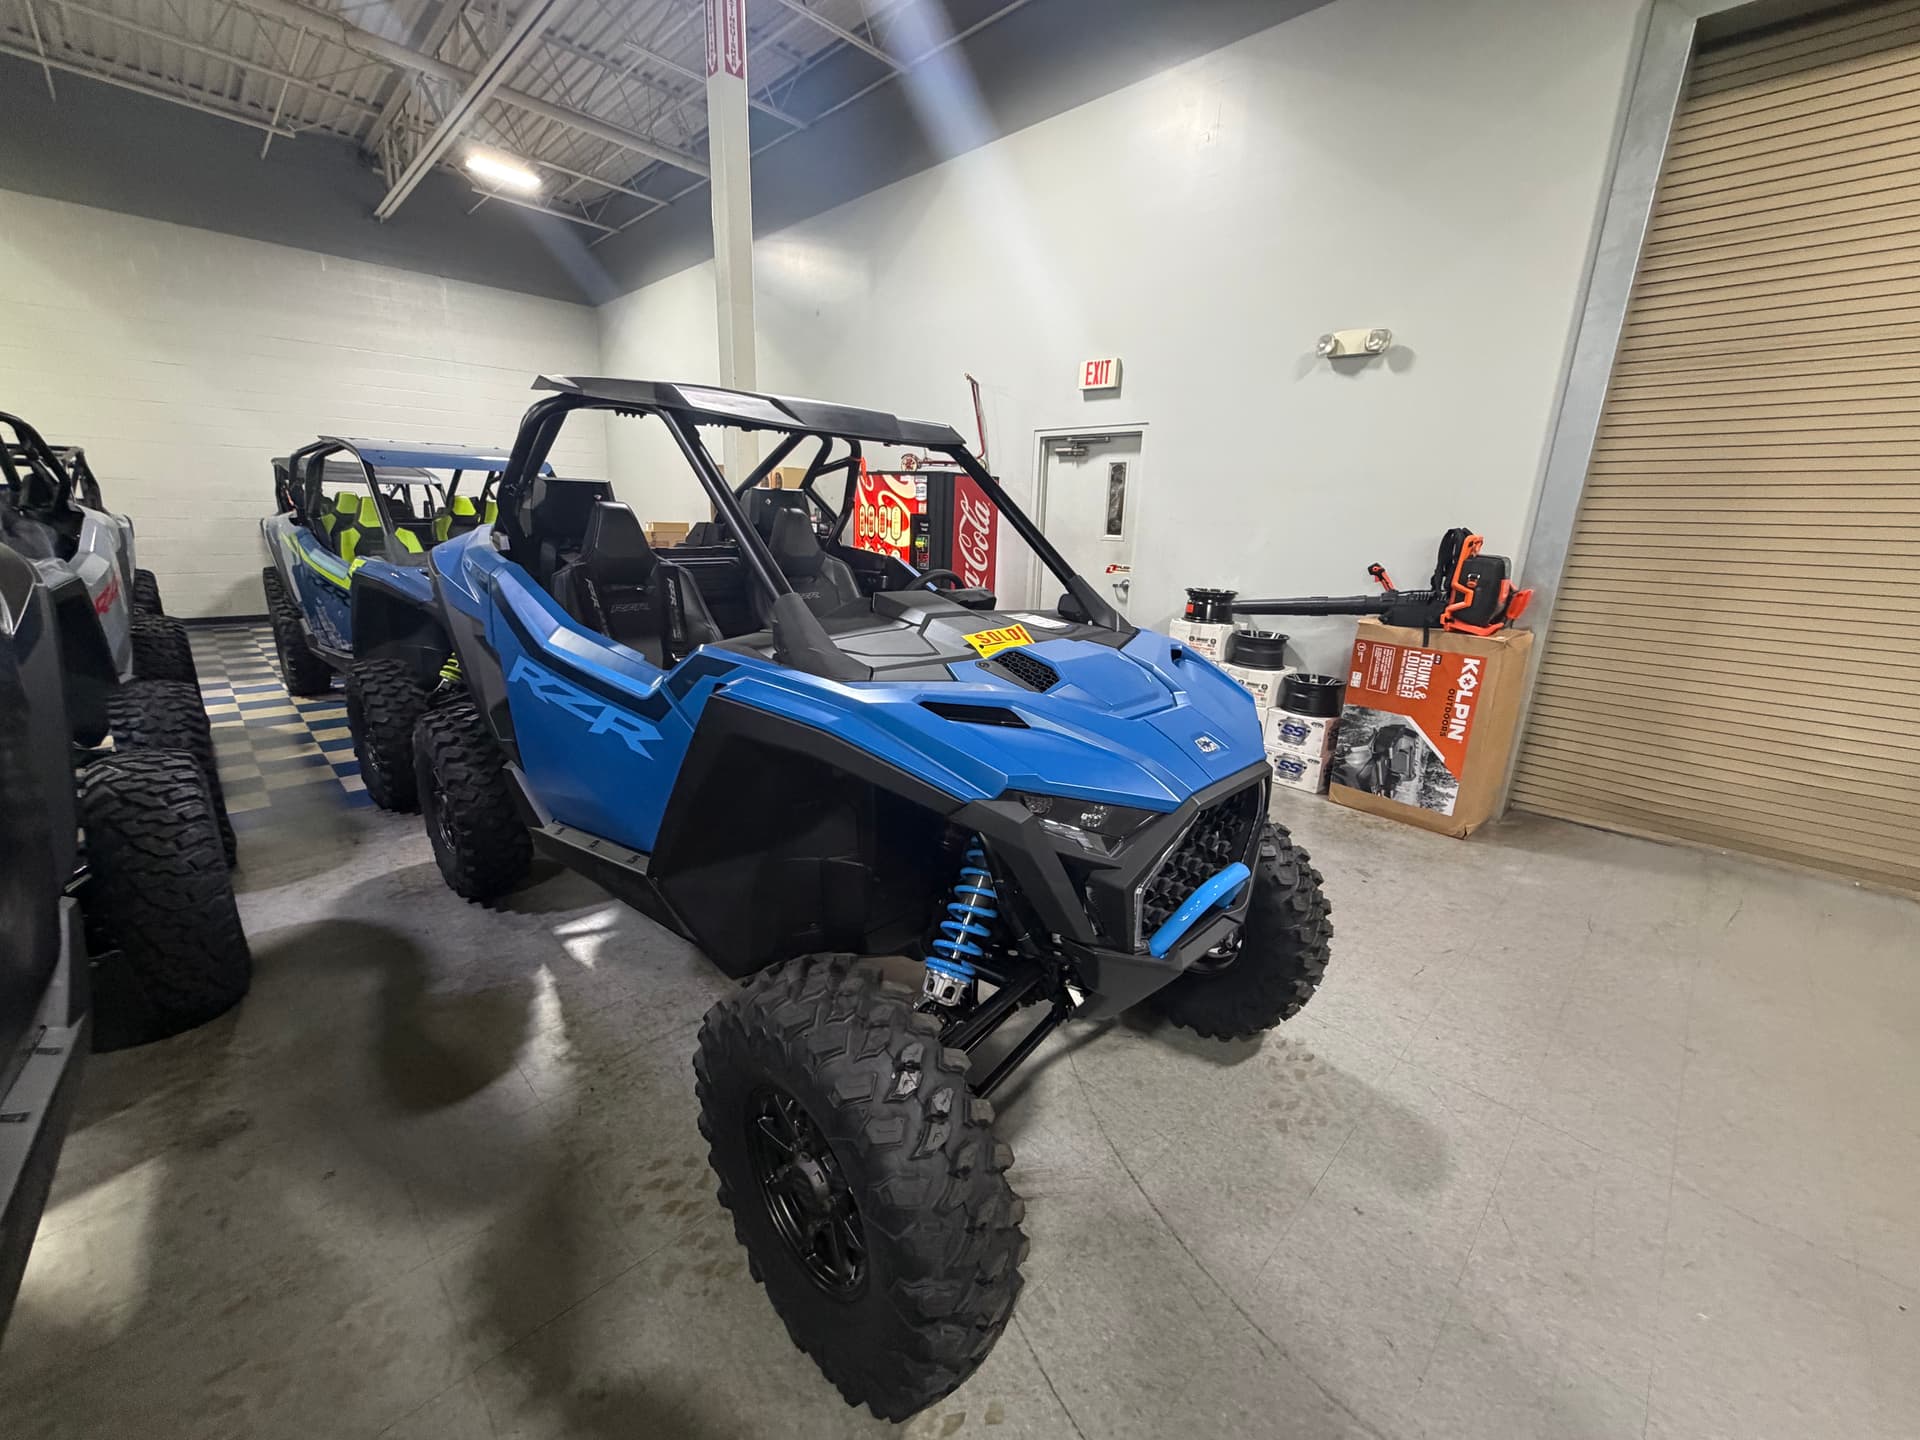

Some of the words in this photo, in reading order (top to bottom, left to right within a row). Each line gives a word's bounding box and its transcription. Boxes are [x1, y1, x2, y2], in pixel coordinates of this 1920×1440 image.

[1085, 359, 1112, 386] EXIT
[1400, 650, 1422, 699] LOUNGER
[1412, 689, 1427, 700] &
[1414, 653, 1434, 690] TRUNK
[508, 655, 664, 761] RZR
[1439, 688, 1456, 737] OUTDOORS
[1447, 657, 1481, 741] KOLPIN
